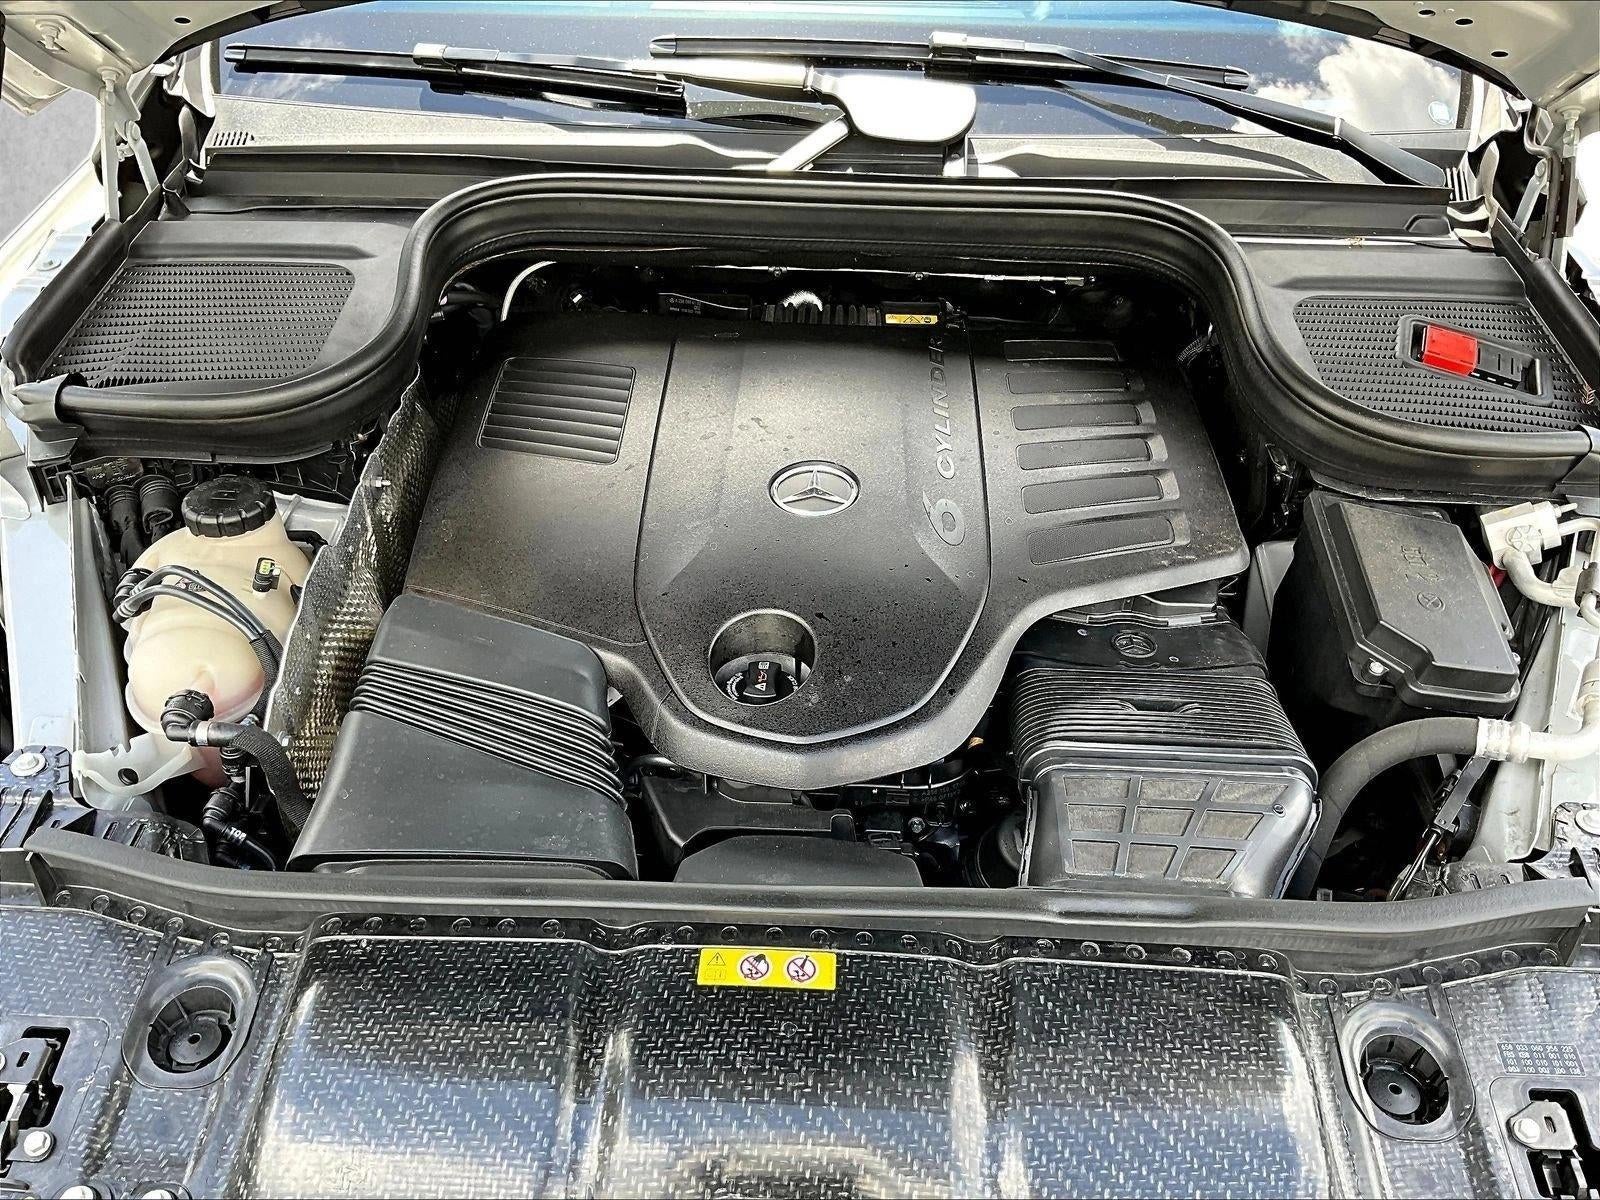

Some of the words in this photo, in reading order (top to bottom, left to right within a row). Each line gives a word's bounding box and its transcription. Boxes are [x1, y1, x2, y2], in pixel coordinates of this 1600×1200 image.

[928, 336, 956, 480] CYLINDER
[922, 491, 966, 546] 6
[230, 826, 247, 842] TOP
